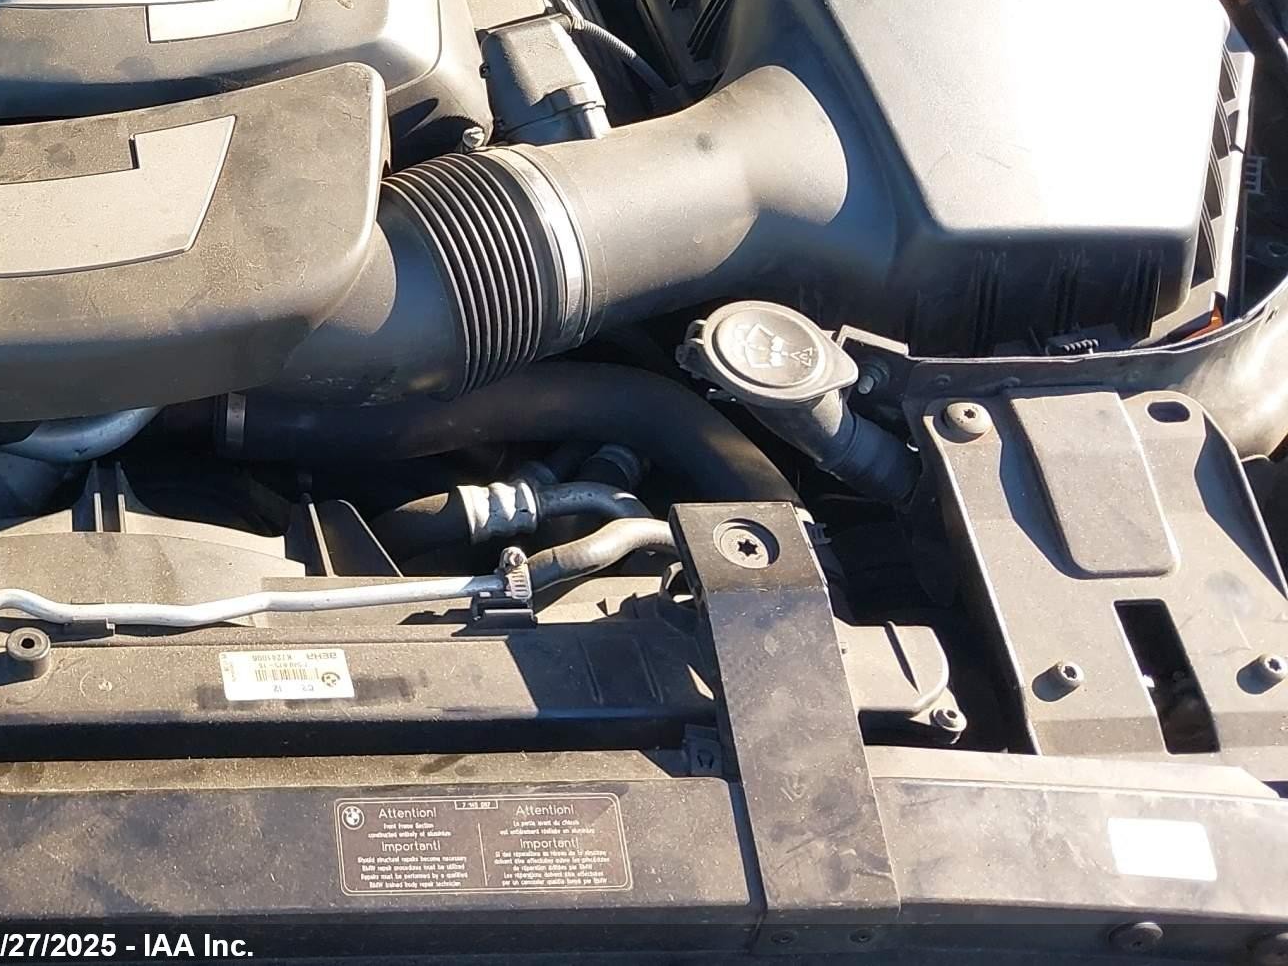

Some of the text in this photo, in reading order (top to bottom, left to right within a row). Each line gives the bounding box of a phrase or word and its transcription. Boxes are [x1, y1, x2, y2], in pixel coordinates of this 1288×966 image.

[379, 807, 437, 819] Attention!
[515, 804, 574, 816] Attention!
[382, 841, 441, 854] Important!
[520, 837, 580, 850] Important!
